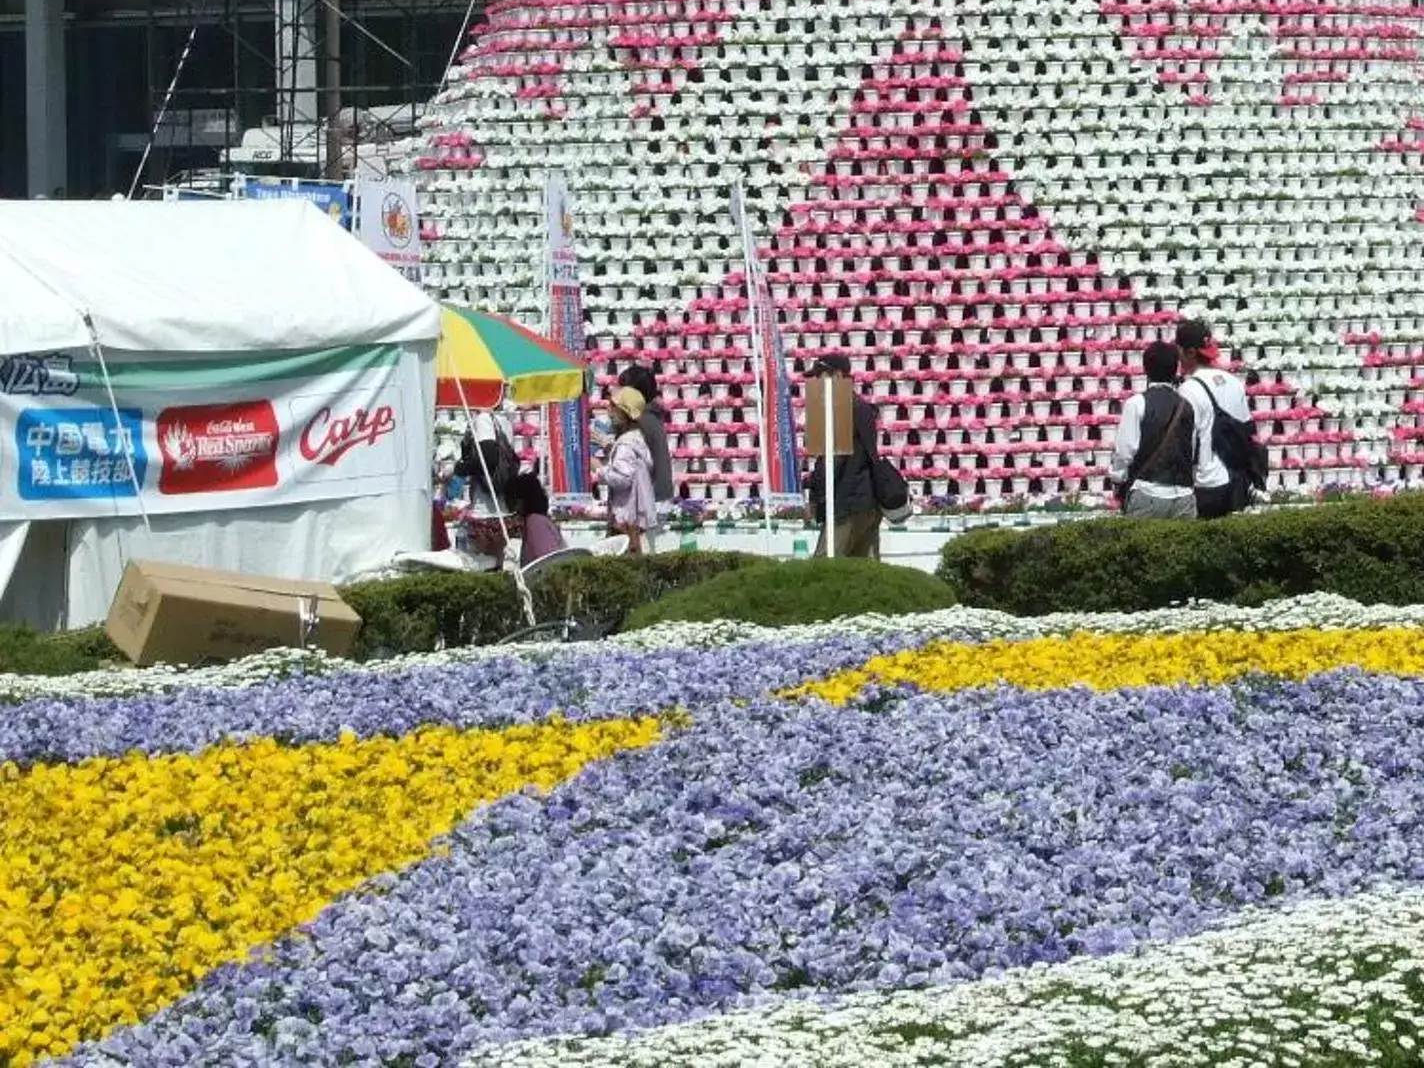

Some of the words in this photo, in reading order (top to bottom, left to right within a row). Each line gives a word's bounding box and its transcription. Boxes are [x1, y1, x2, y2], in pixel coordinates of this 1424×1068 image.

[0, 353, 80, 396] 広島
[27, 422, 135, 457] 中国電力
[196, 436, 224, 456] Red
[299, 404, 396, 466] Carp
[31, 457, 136, 486] 陸上競技部
